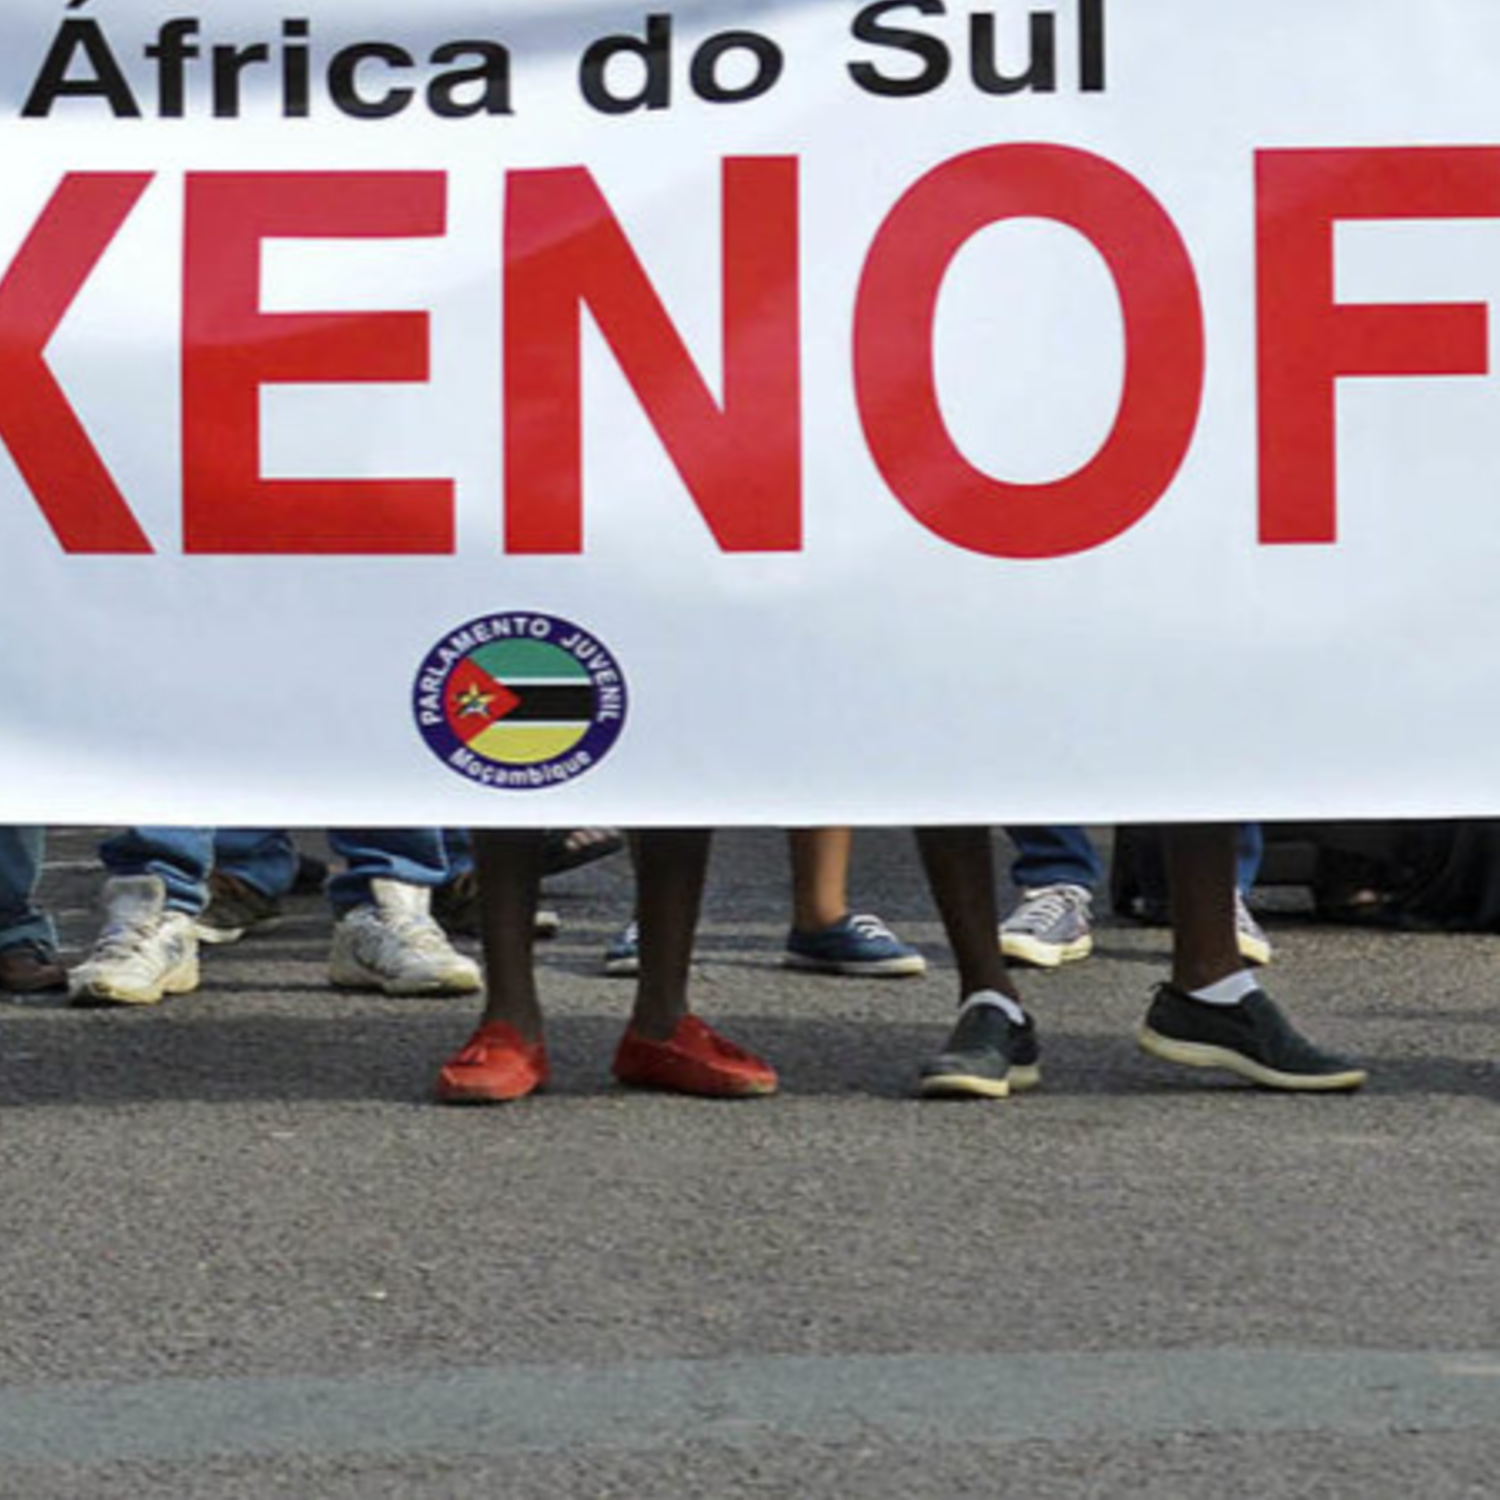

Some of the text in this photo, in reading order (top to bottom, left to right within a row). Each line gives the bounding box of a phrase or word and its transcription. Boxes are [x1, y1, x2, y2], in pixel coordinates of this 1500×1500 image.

[577, 13, 785, 114] do
[419, 617, 622, 726] PARLAMENTO JUVENIL
[450, 747, 592, 785] Moçambique
